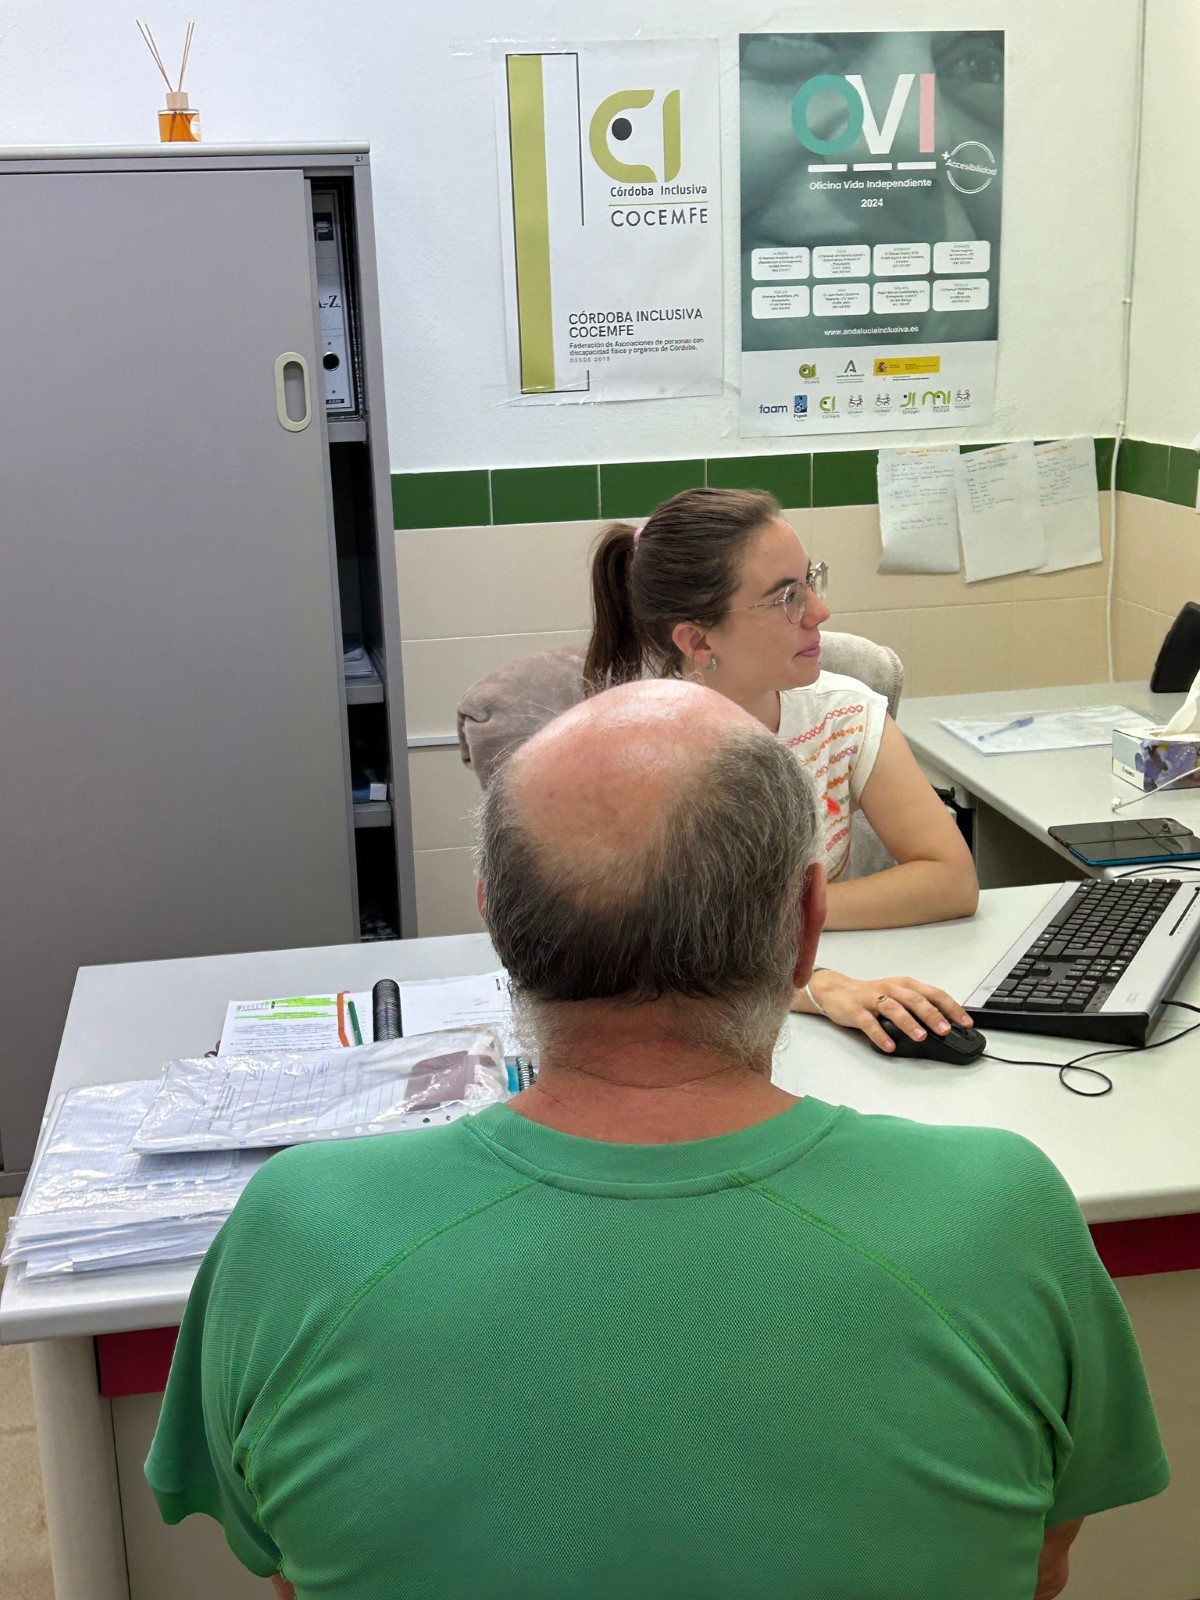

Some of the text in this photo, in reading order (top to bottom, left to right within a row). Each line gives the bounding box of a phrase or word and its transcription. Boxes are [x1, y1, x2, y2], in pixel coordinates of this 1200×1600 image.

[791, 73, 936, 155] OVI
[610, 184, 707, 197] Córdoba Inclusiva
[810, 179, 932, 190] Oficina Vida Independiente
[861, 198, 884, 208] 2024
[611, 207, 708, 227] COCEMFE
[569, 308, 703, 325] CÓRDOBA INCLUSIVA
[569, 325, 634, 338] COCEMFE
